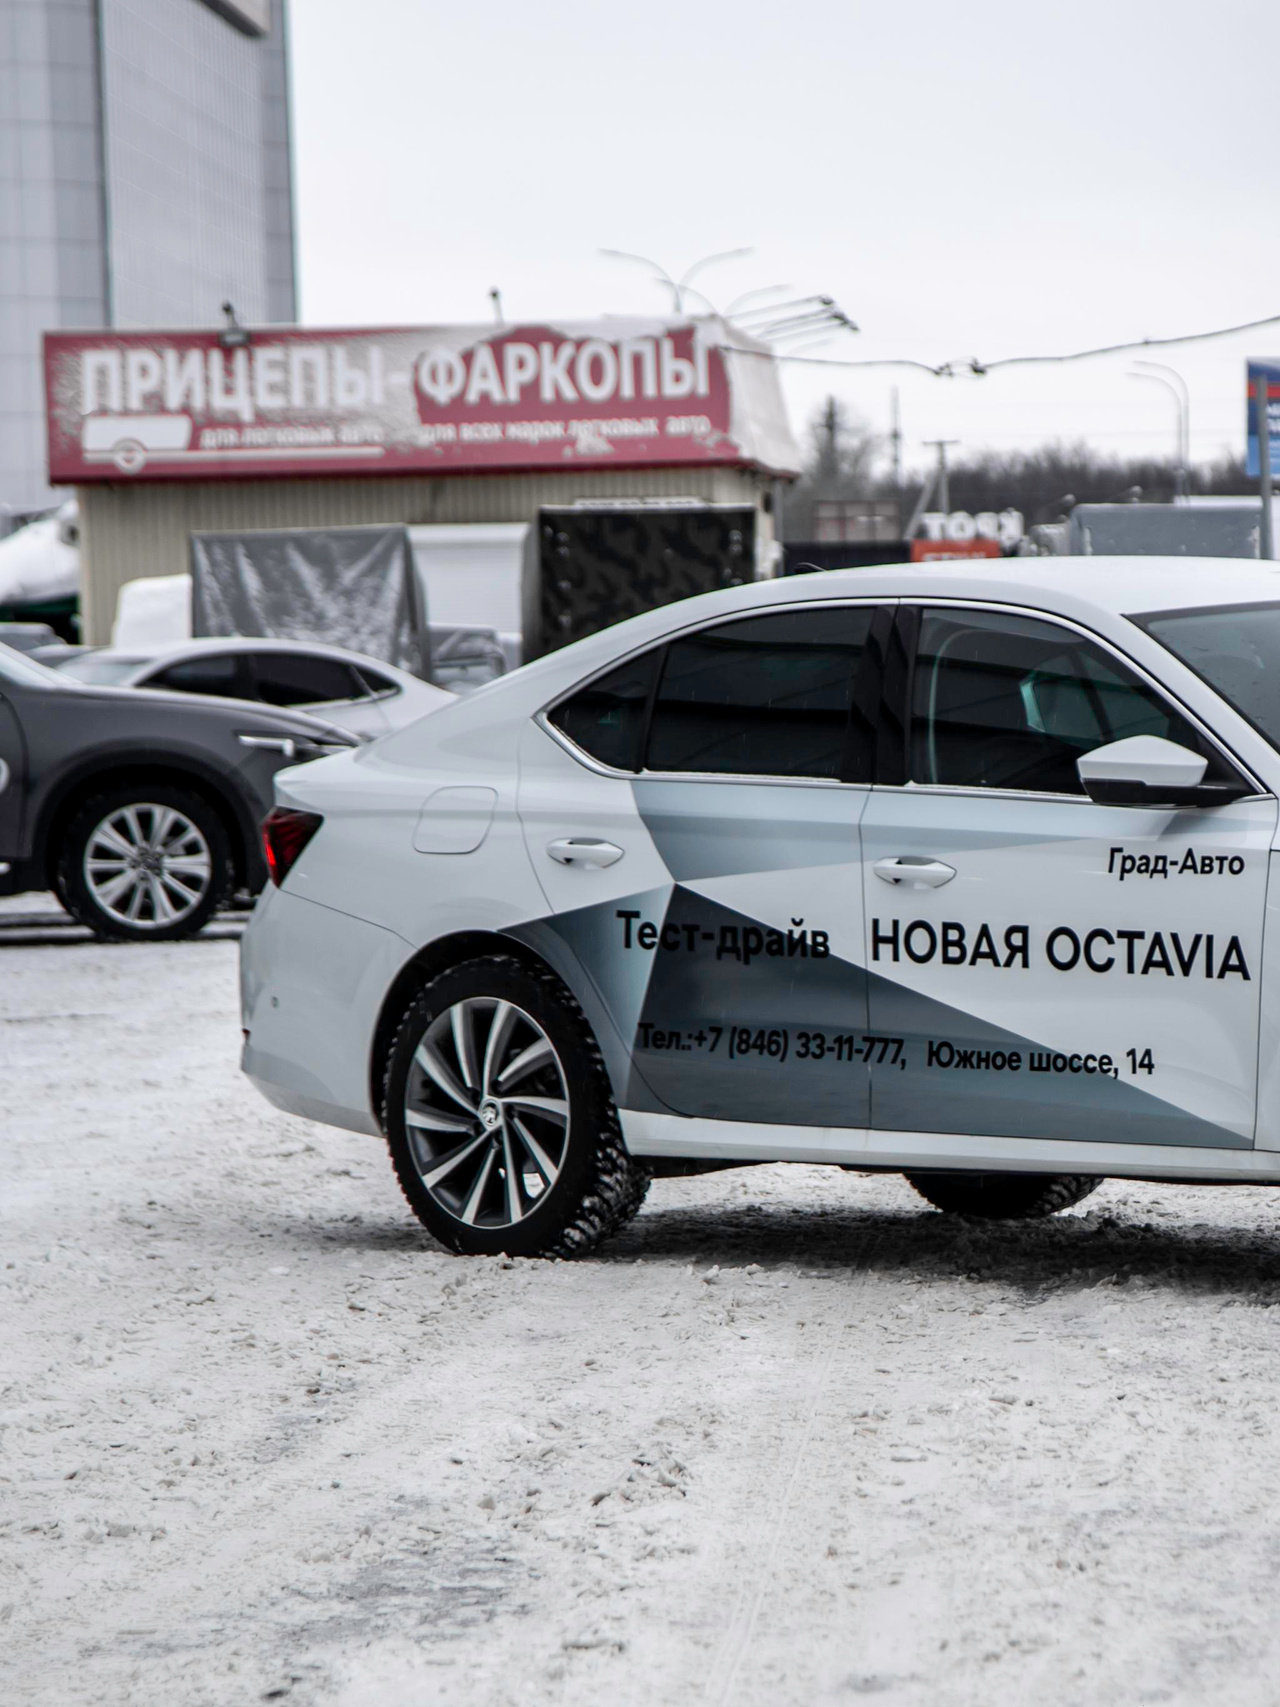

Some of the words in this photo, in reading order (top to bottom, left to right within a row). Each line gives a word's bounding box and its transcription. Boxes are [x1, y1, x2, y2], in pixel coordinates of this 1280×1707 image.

[1108, 847, 1245, 881] Град-Авто
[616, 910, 830, 965] Тест-драйв
[872, 918, 1029, 968] НОВАЯ
[1046, 926, 1251, 980] OCTAVIA
[729, 1026, 789, 1062] (846)
[796, 1032, 906, 1069] 33-11-777,
[928, 1041, 1021, 1070] Южное
[1029, 1051, 1118, 1079] шоссе,
[1126, 1048, 1154, 1075] 14
